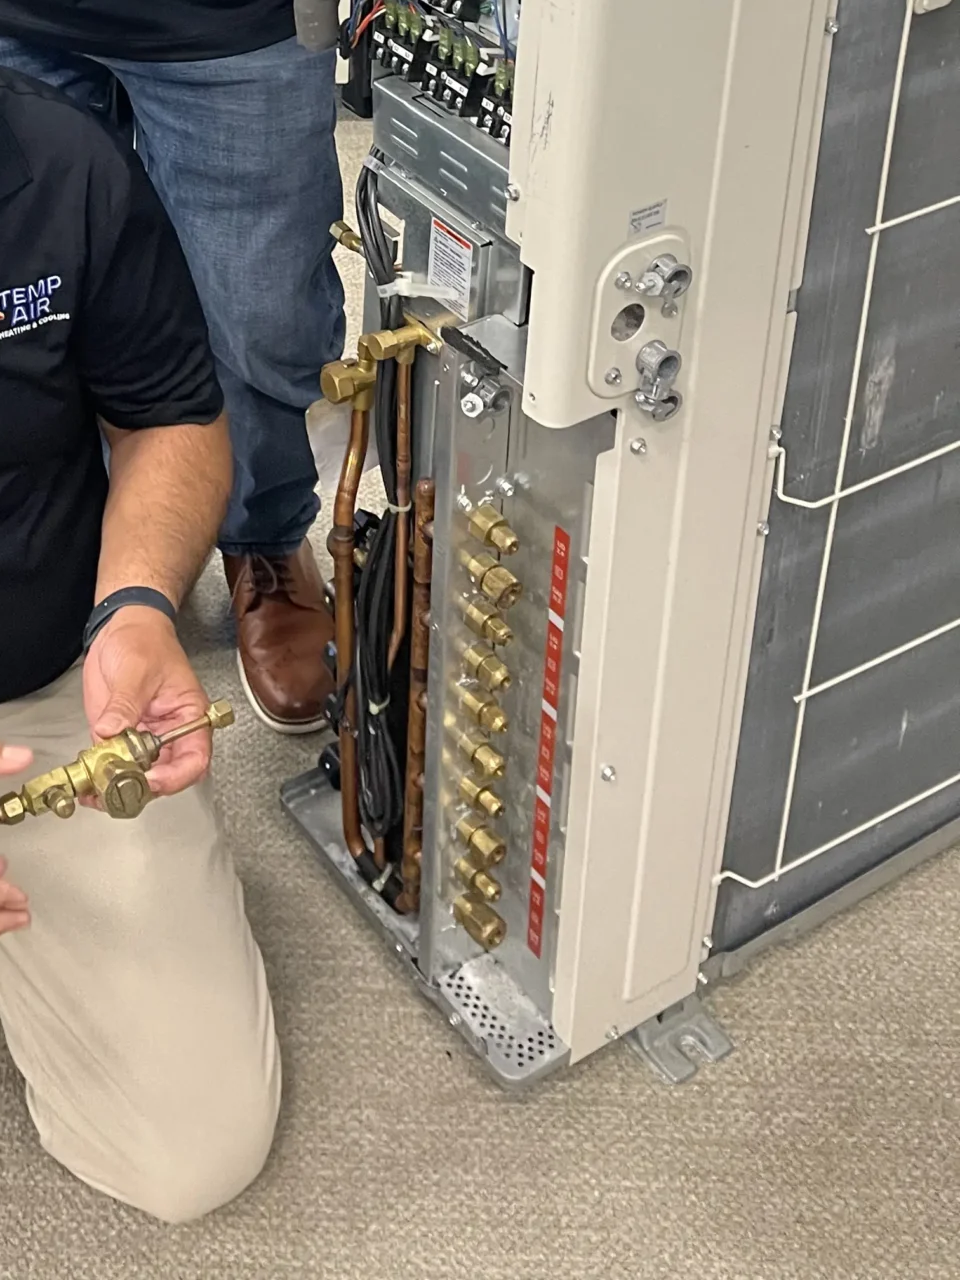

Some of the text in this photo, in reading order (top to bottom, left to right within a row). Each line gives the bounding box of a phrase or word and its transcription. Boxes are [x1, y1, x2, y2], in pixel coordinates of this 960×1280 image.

[11, 297, 51, 326] AIR
[32, 321, 38, 329] &
[38, 312, 70, 325] COOLING
